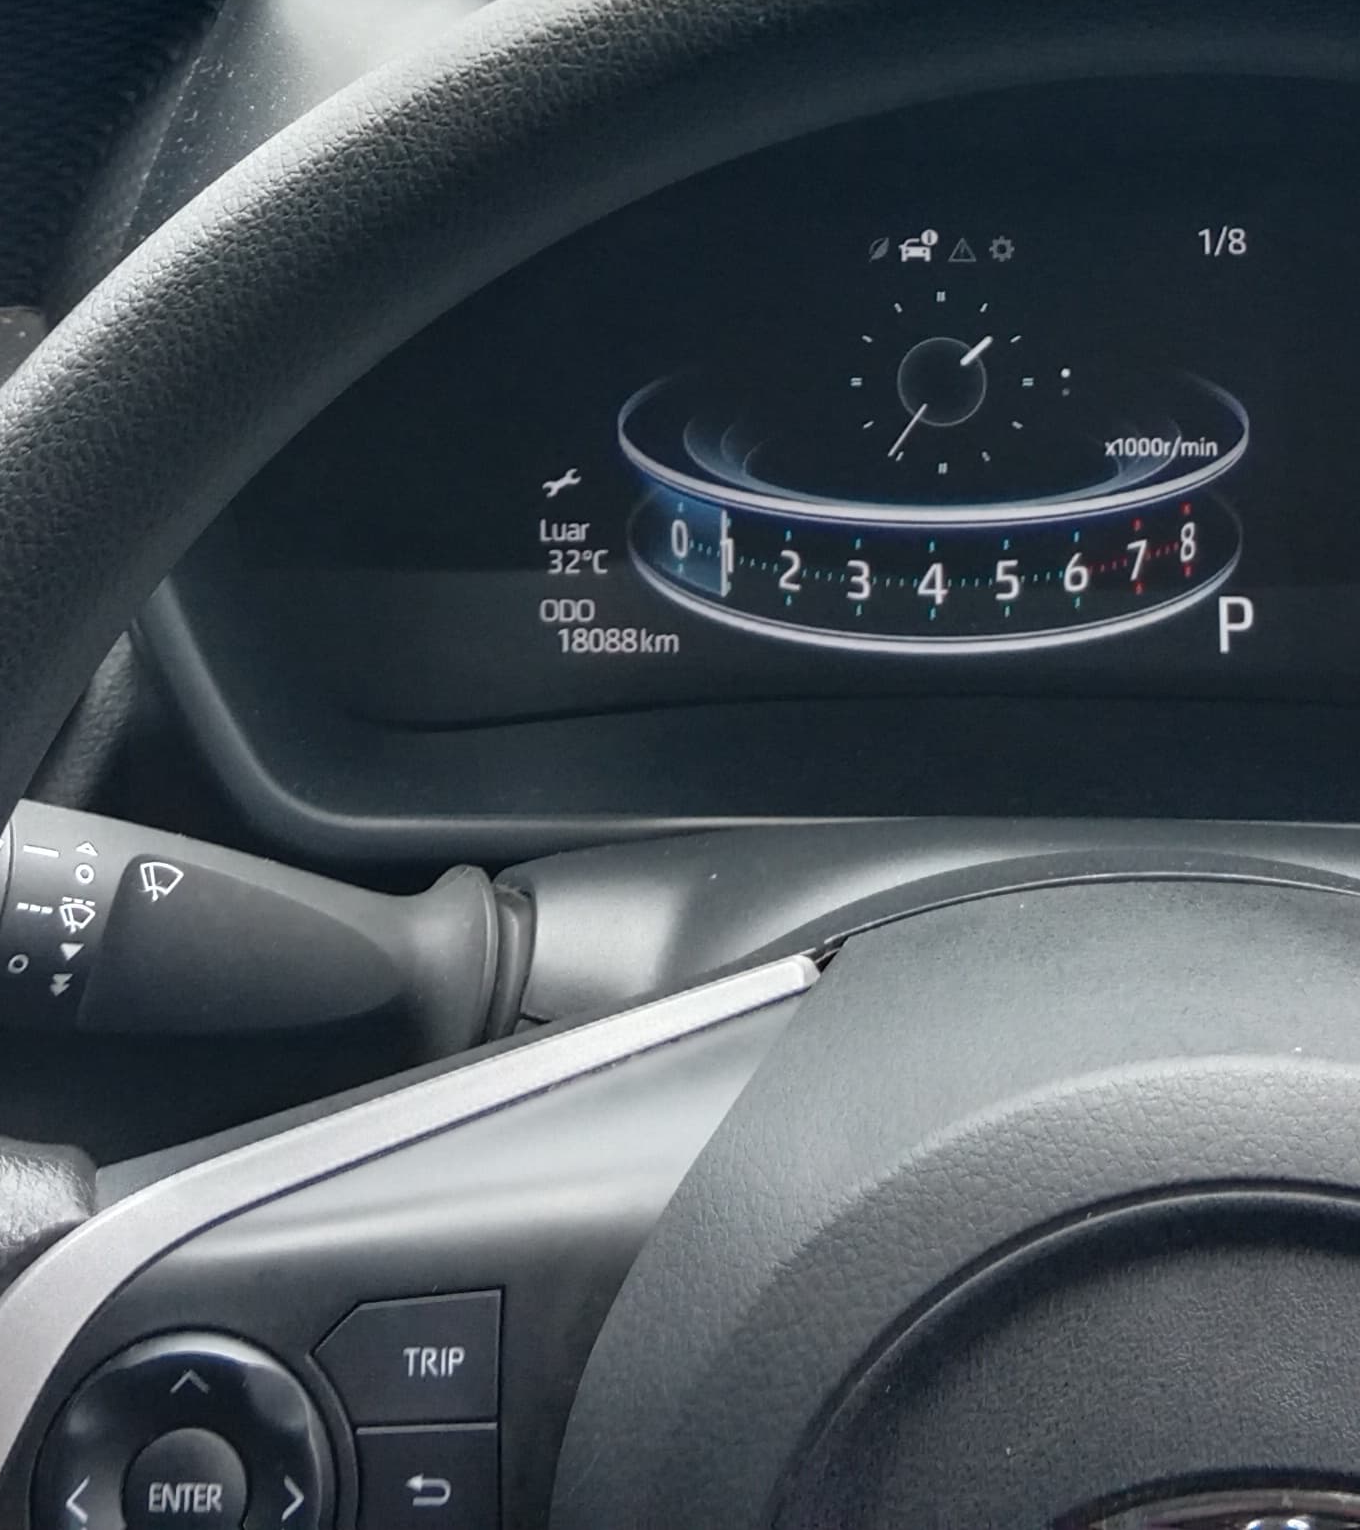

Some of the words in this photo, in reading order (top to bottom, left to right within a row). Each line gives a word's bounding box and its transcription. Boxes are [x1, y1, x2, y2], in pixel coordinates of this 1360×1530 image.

[1198, 225, 1247, 257] 1/8
[1104, 436, 1219, 459] x1000r/min
[540, 519, 590, 542] Luar
[548, 549, 609, 575] 32°C
[671, 519, 688, 558] 0
[778, 550, 801, 591] 2
[846, 560, 871, 600] 3
[916, 563, 948, 605] 4
[994, 559, 1020, 600] 5
[1063, 552, 1089, 592] 6
[1126, 539, 1148, 581] 7
[1180, 522, 1196, 562] 8
[540, 599, 596, 623] ODO
[1218, 596, 1254, 654] P
[403, 1346, 465, 1378] TRIP
[148, 1482, 223, 1513] ENTER
